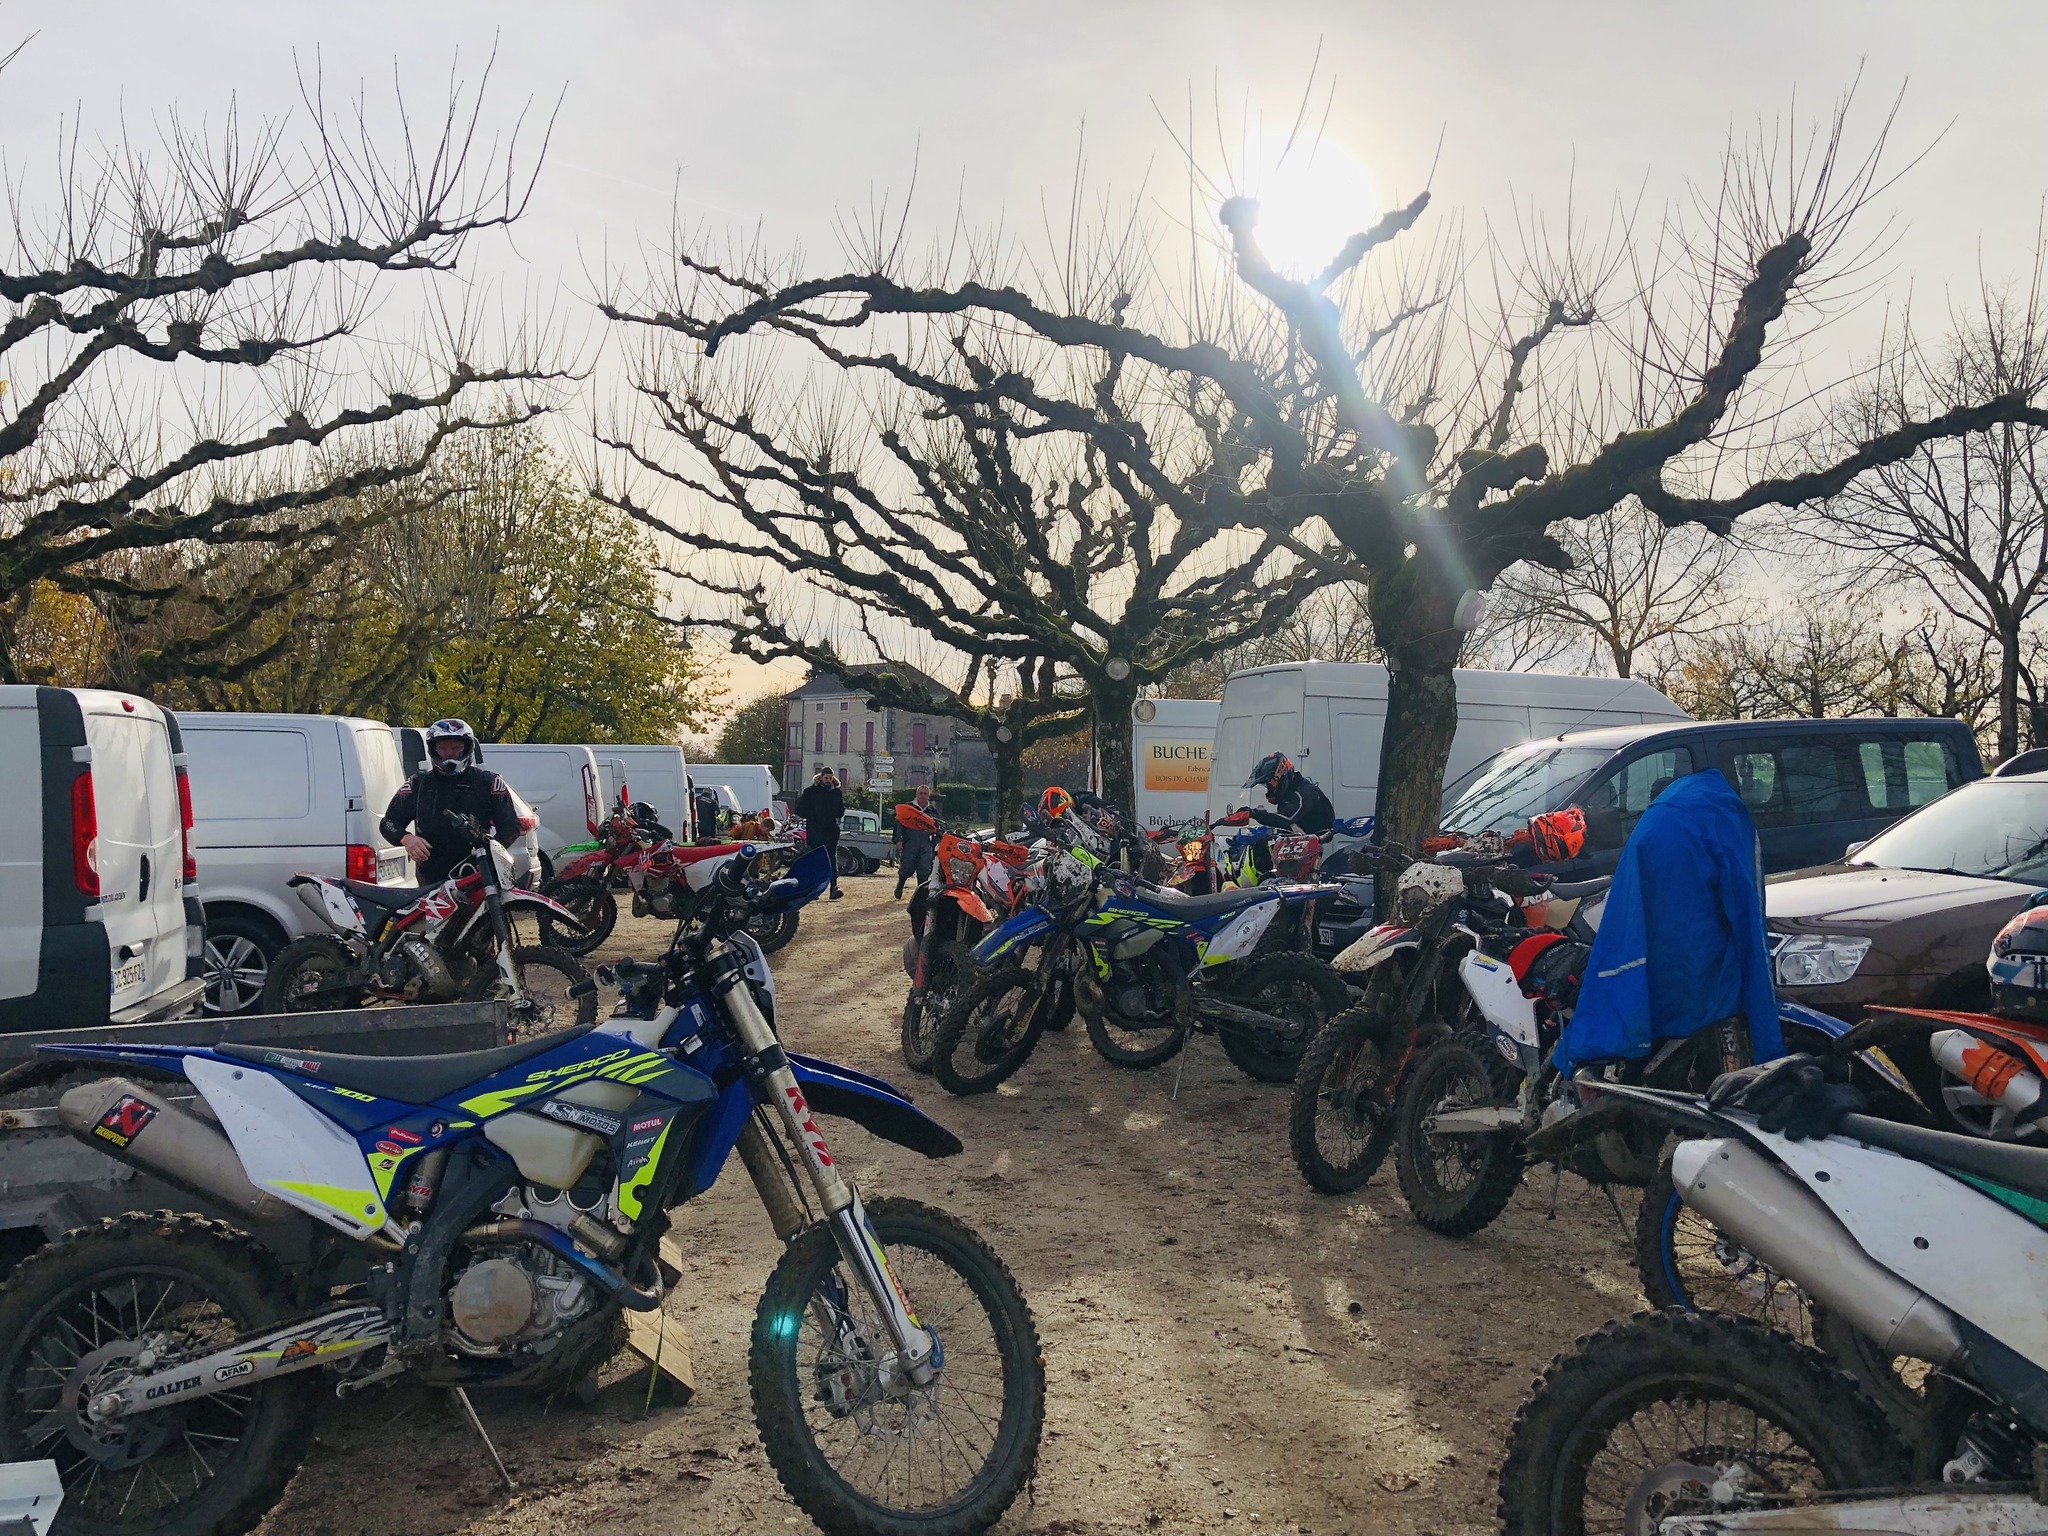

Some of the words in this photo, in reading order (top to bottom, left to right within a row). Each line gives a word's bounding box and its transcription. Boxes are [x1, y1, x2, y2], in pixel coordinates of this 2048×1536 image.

[1152, 745, 1208, 760] BUCHE
[1107, 907, 1149, 917] SHERCO
[525, 1049, 631, 1083] SHERCO
[327, 1086, 377, 1103] 300
[632, 1118, 662, 1132] MOTUL
[220, 1363, 250, 1379] AFAM
[145, 1375, 202, 1400] GALFER
